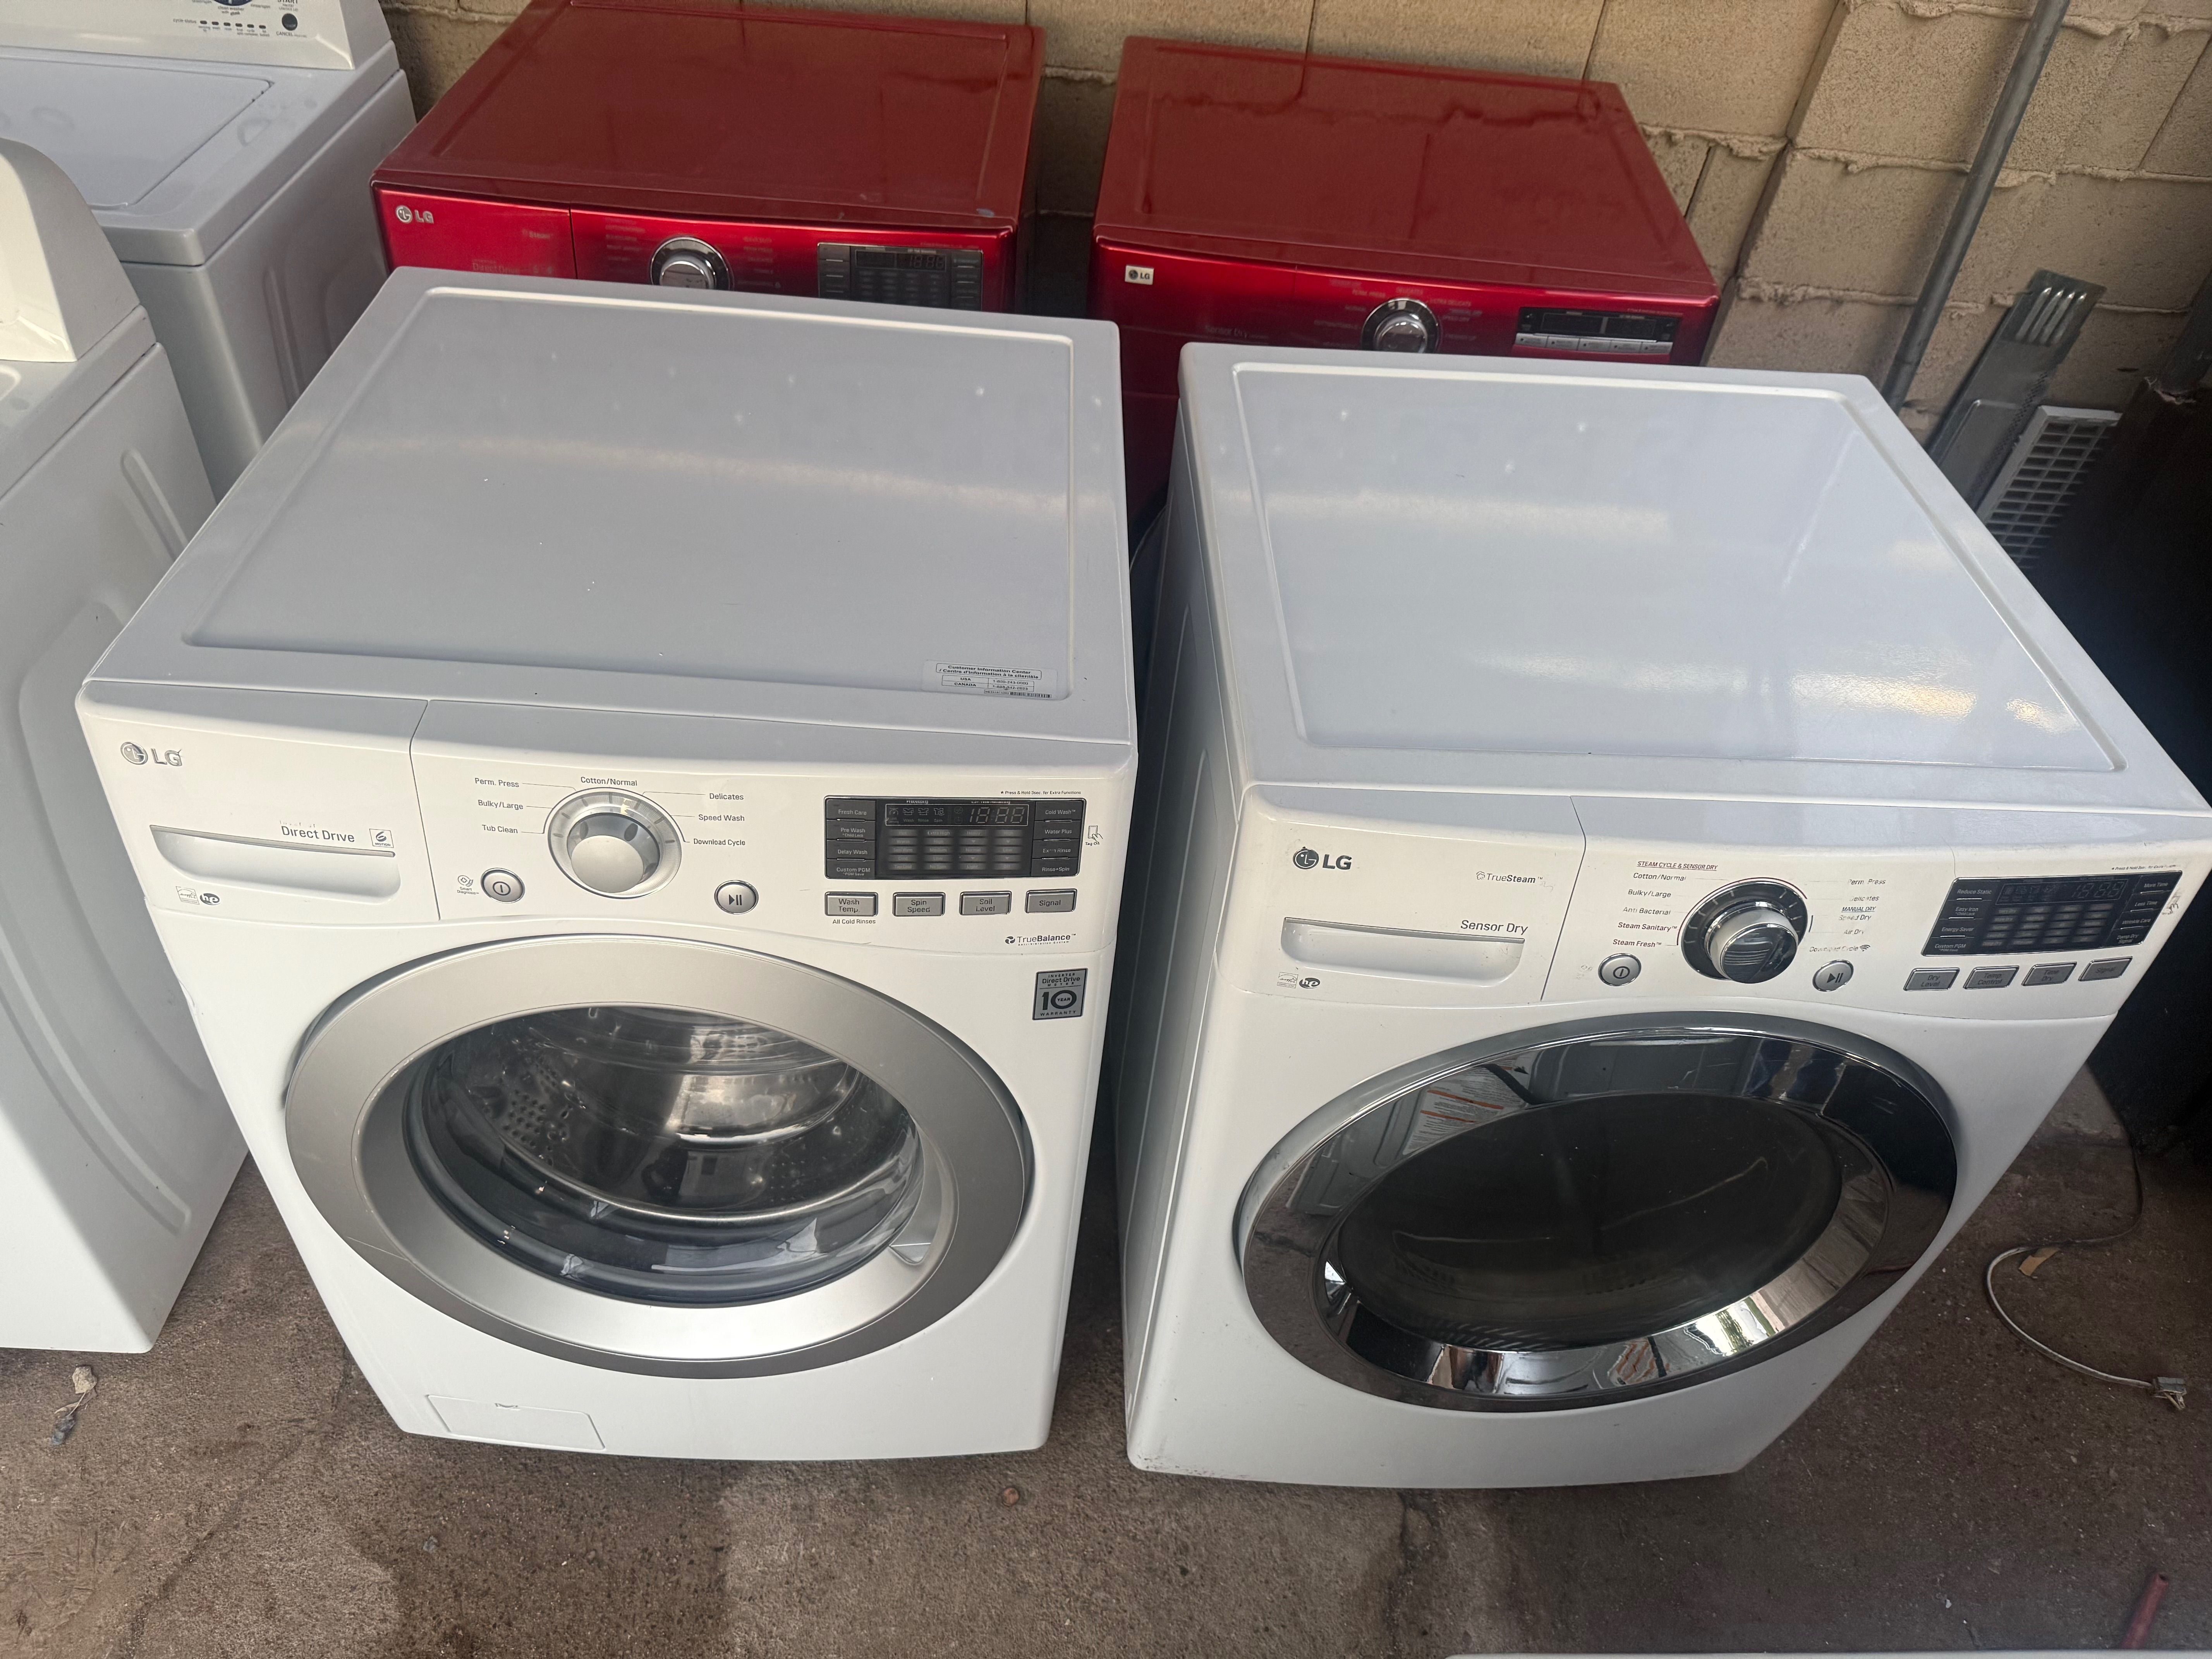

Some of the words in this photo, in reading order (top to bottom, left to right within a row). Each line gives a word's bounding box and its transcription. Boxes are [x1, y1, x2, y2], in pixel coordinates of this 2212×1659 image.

[414, 210, 434, 224] LG
[151, 748, 182, 766] LG
[475, 778, 497, 786] Perm.
[498, 780, 519, 788] Press
[581, 776, 637, 787] Cotton/Normal
[478, 800, 523, 811] Bulky/Large
[282, 826, 319, 839] Direct
[322, 830, 355, 843] Drive
[1322, 854, 1352, 871] LG
[1628, 889, 1671, 898] Bulky/Large
[1461, 920, 1504, 932] Sensor
[1506, 923, 1528, 935] Dry
[1042, 990, 1077, 1010] 10
